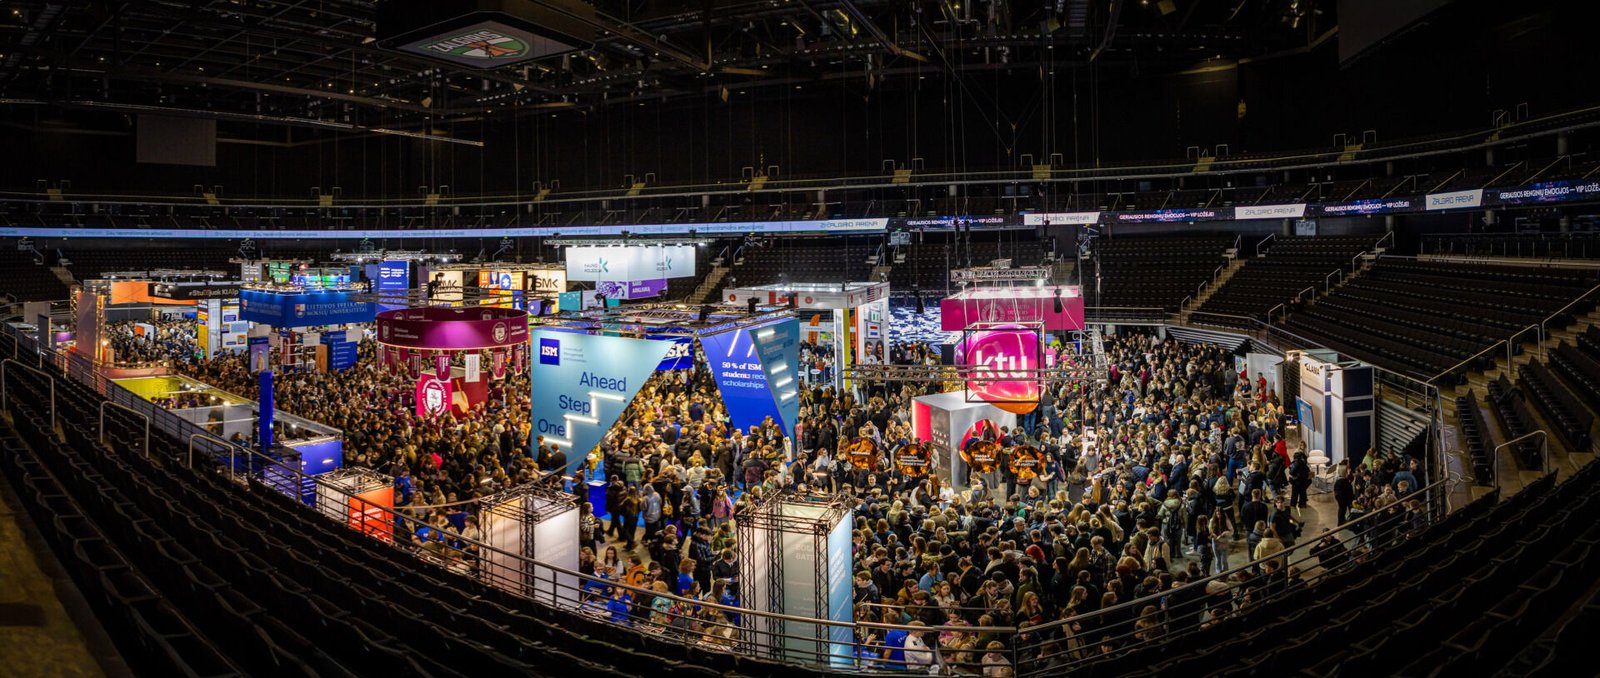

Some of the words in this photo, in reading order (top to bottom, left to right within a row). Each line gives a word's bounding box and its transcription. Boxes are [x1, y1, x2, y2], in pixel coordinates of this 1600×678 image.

[536, 278, 558, 289] SMK
[541, 346, 558, 357] ISM
[722, 361, 731, 369] 50
[975, 350, 1028, 379] ktu
[722, 371, 751, 379] students
[579, 371, 627, 392] Ahead
[722, 380, 765, 389] scholarships
[558, 394, 591, 415] Step
[537, 418, 566, 437] One
